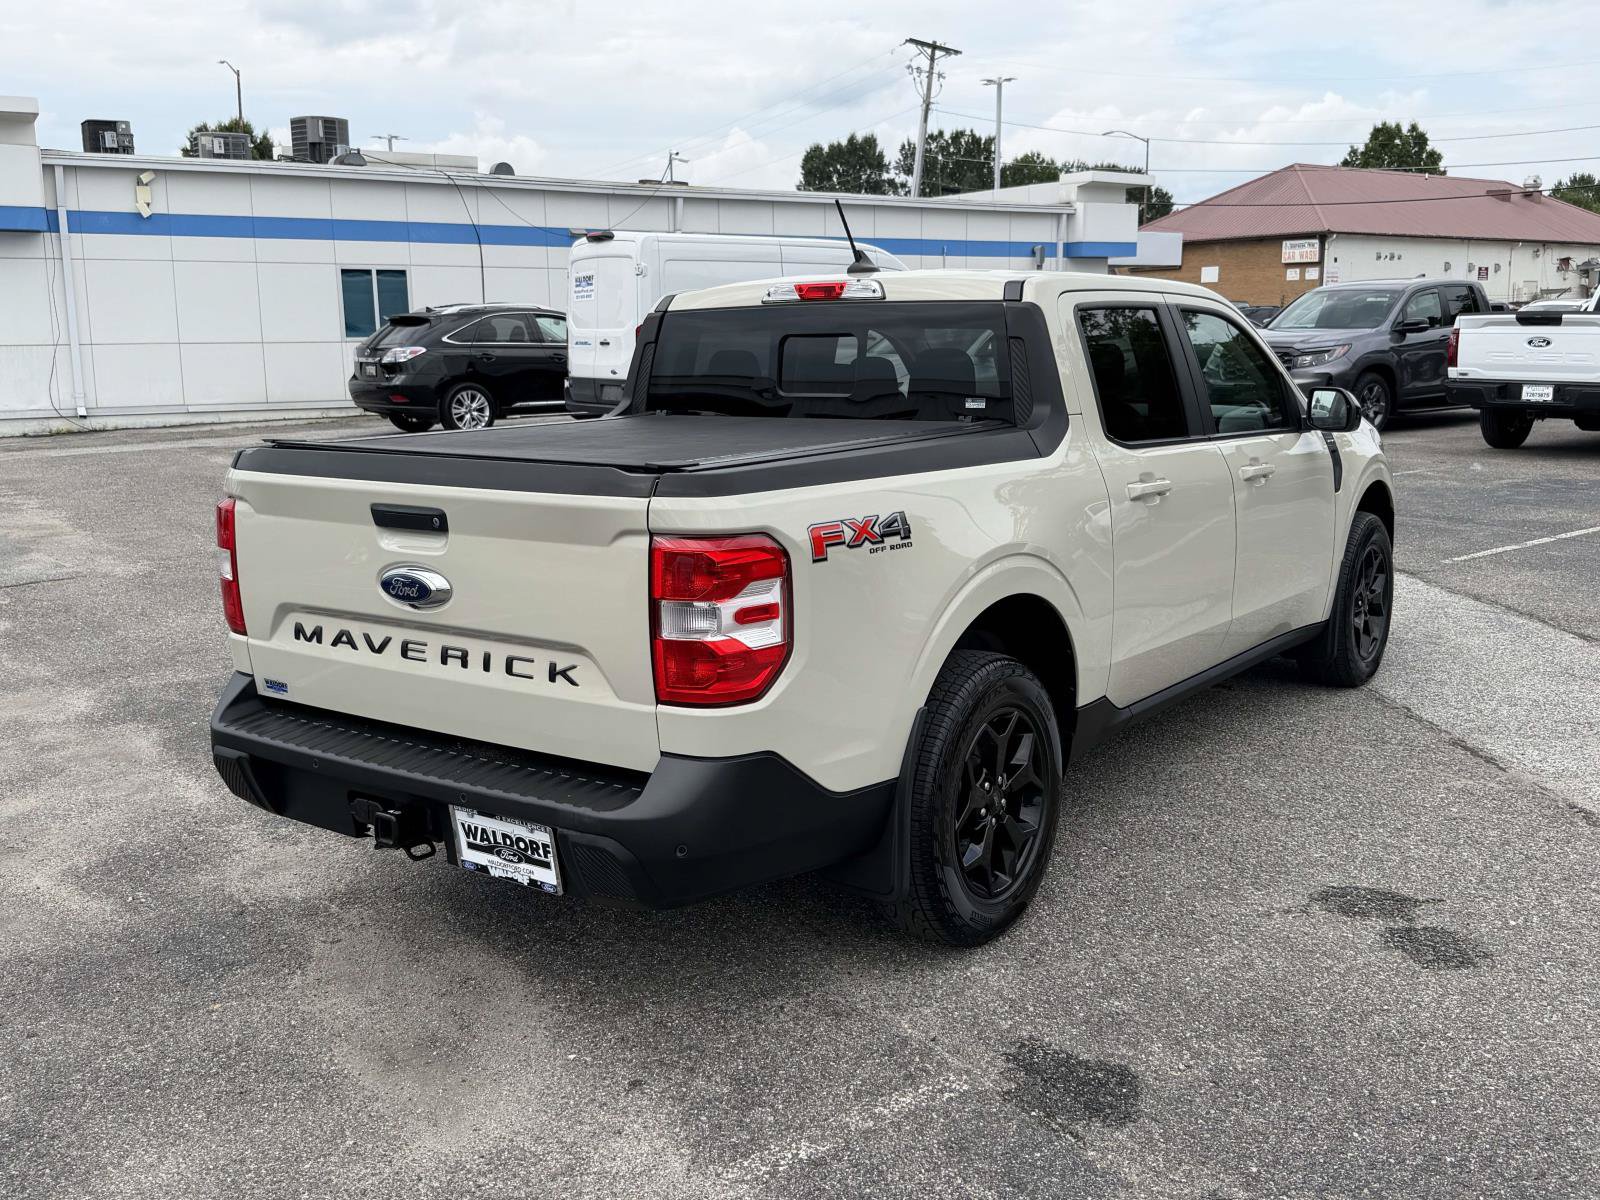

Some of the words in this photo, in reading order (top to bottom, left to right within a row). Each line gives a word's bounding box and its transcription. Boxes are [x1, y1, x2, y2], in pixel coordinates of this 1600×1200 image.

[1283, 250, 1296, 262] CAR
[1299, 249, 1318, 261] WASH
[807, 511, 911, 564] FX4
[869, 544, 887, 555] OFF
[889, 541, 913, 551] ROAD
[389, 577, 420, 597] Ford
[294, 621, 580, 687] MAVERICK
[502, 816, 545, 832] EXCELLENCE
[461, 822, 552, 859] WALDORF
[500, 849, 519, 863] Ford
